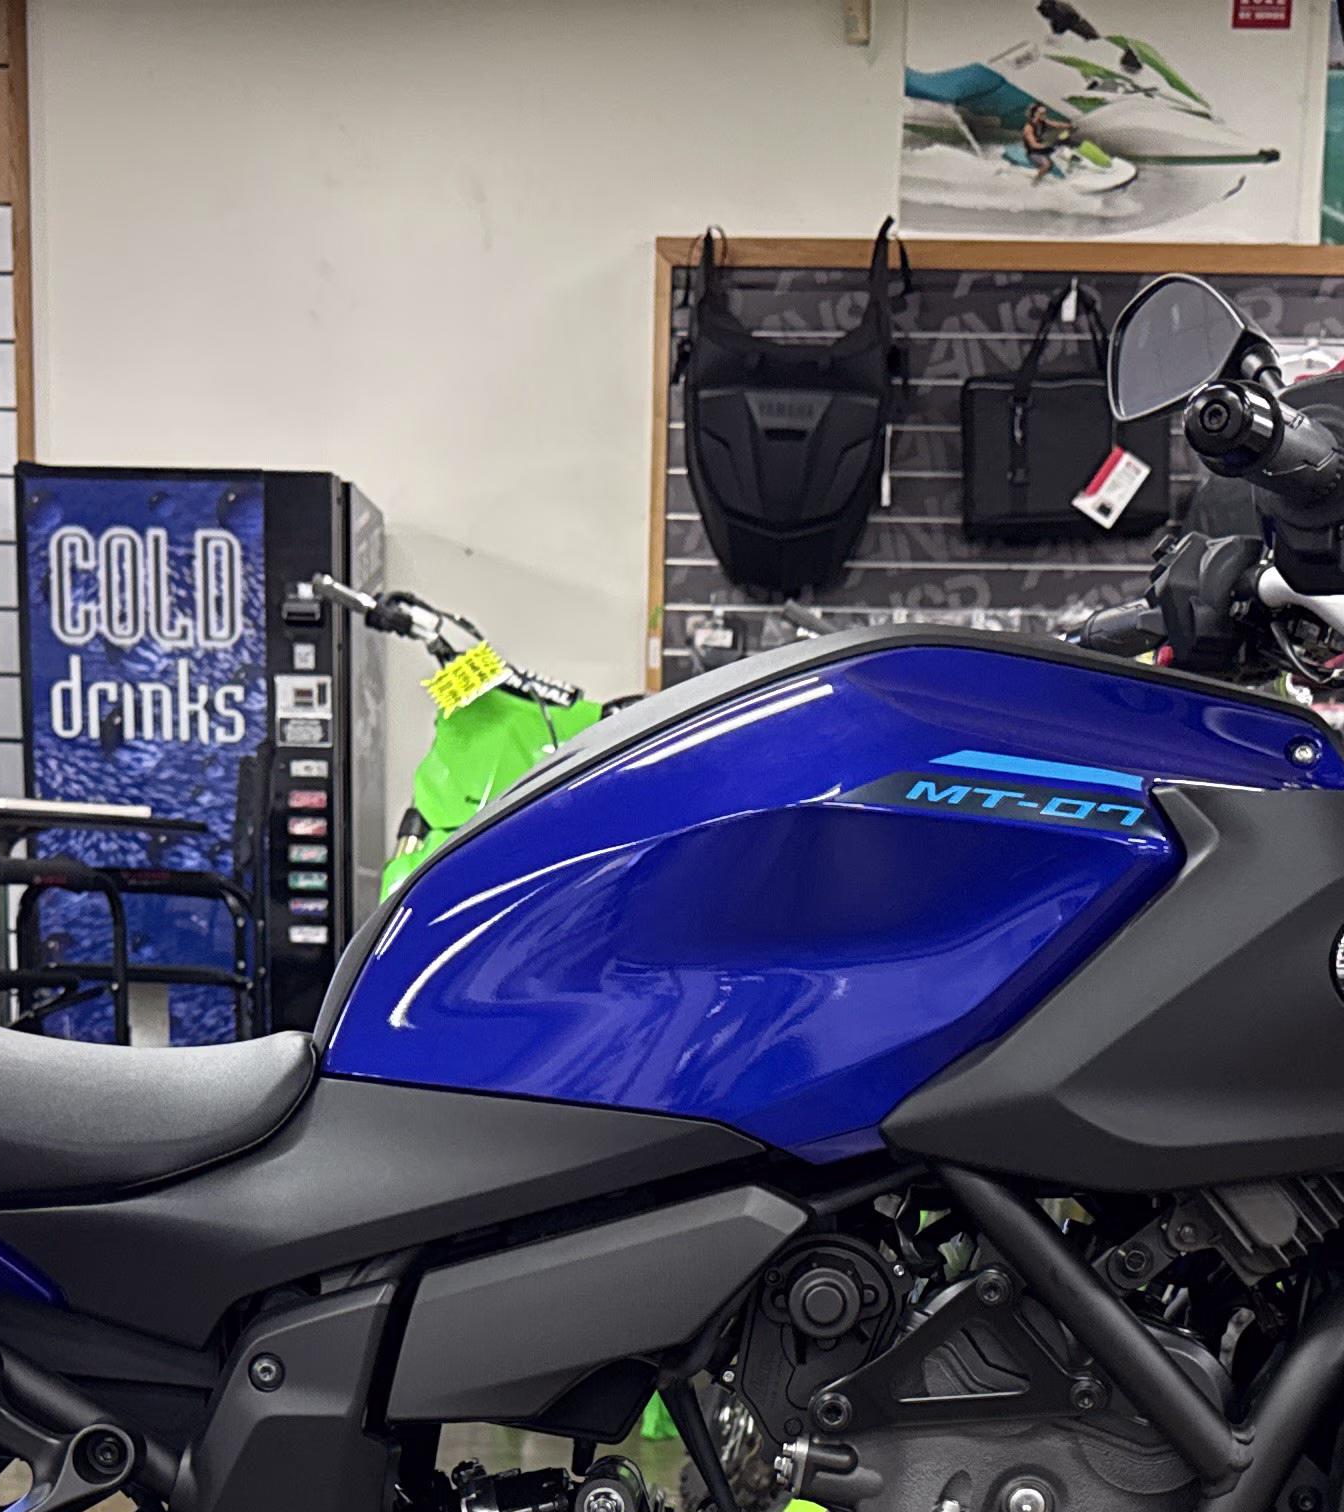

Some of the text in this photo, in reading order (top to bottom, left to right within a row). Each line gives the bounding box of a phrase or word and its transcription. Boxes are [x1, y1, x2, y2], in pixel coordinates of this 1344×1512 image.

[49, 526, 244, 650] COLD
[49, 653, 246, 745] drinks
[904, 779, 1146, 828] MT-07
